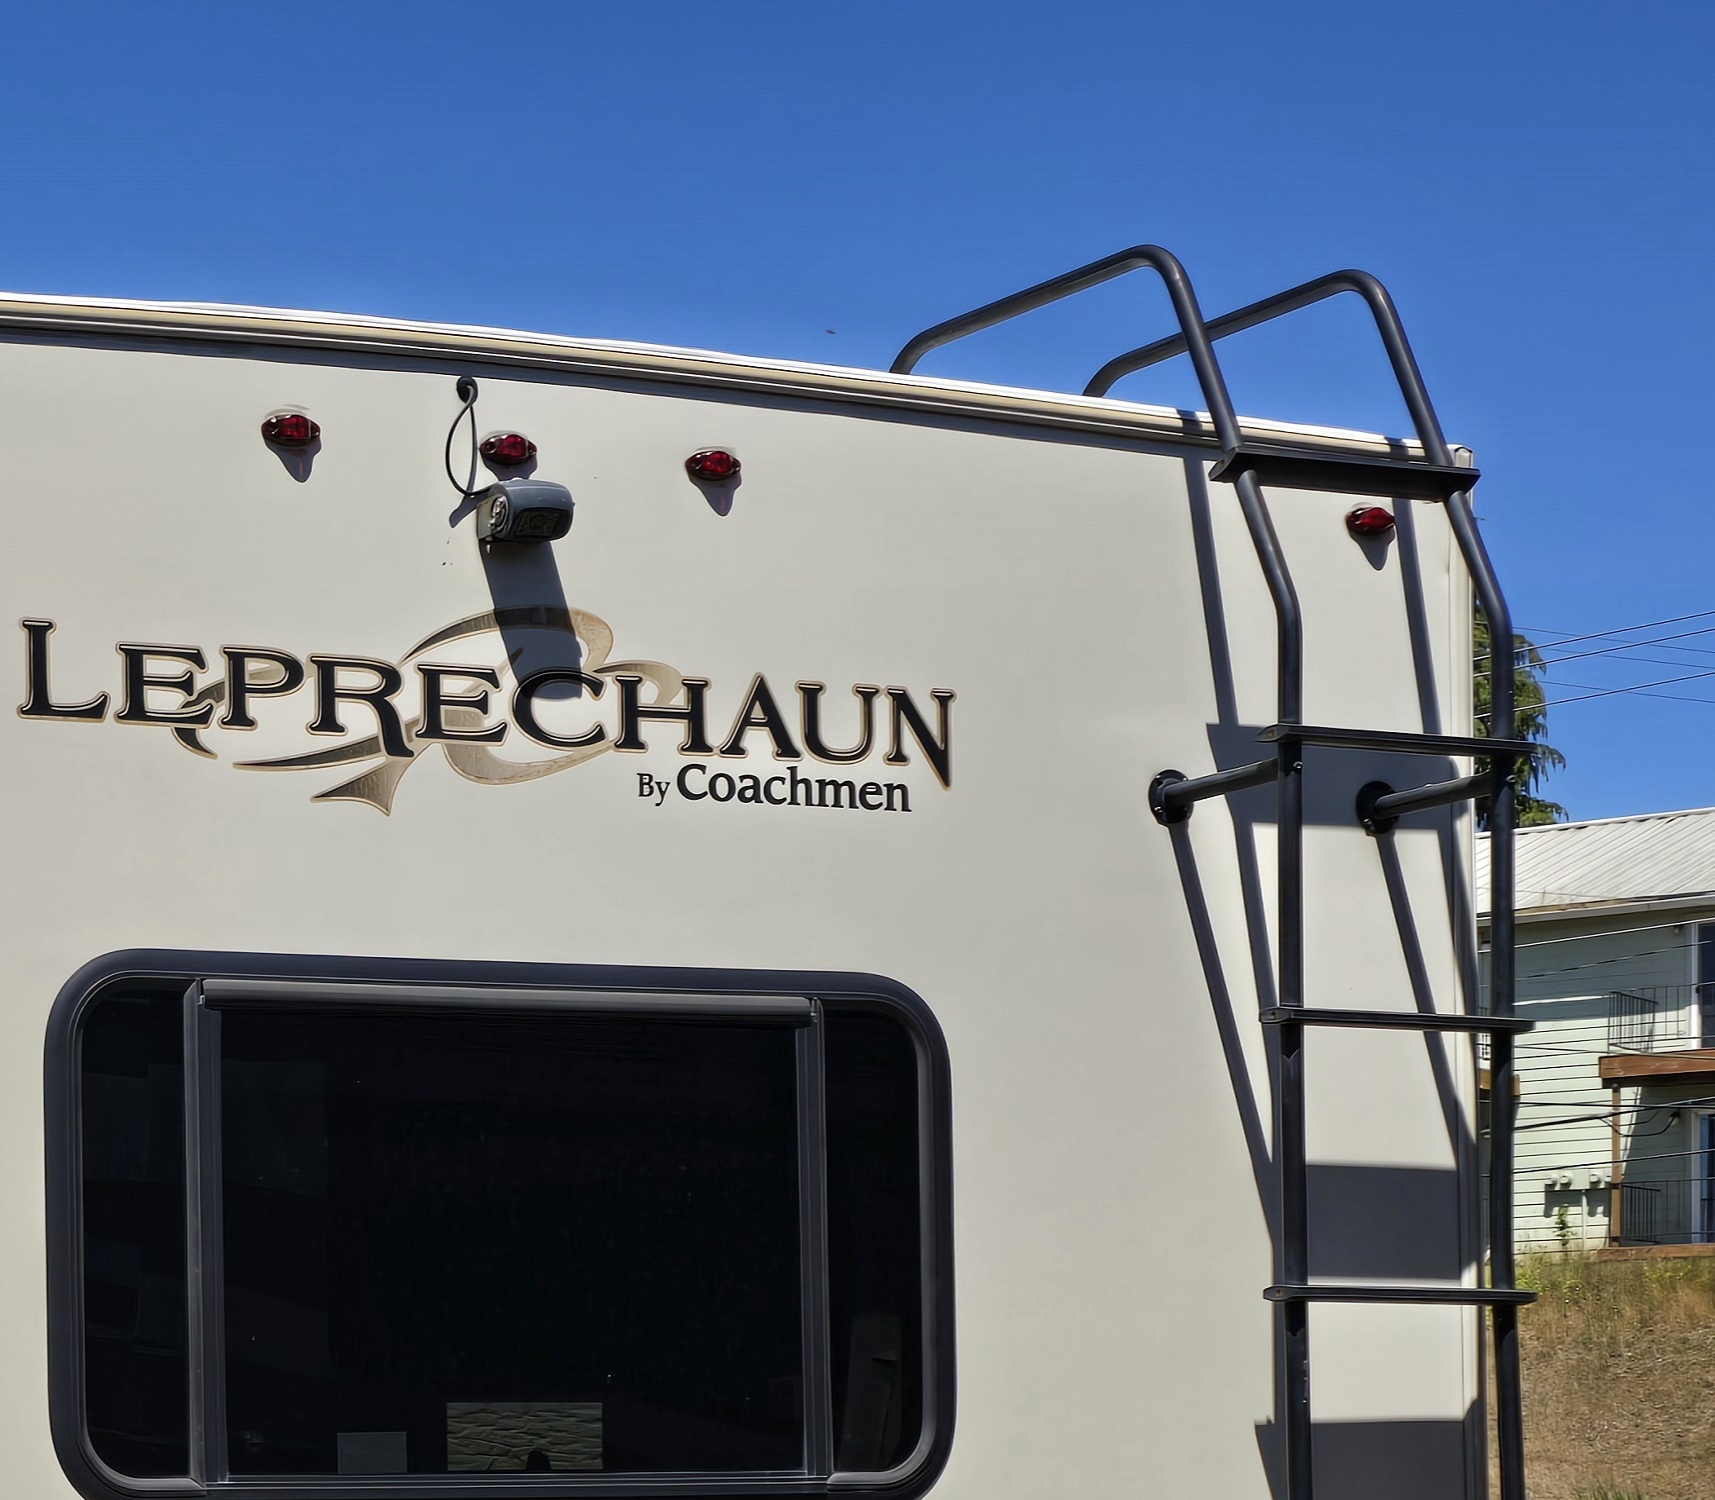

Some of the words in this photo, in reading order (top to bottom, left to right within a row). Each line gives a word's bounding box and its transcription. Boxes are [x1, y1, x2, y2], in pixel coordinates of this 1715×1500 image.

[18, 617, 957, 790] LEPRECHAUN
[636, 771, 671, 808] By
[676, 763, 913, 813] Coachmen
